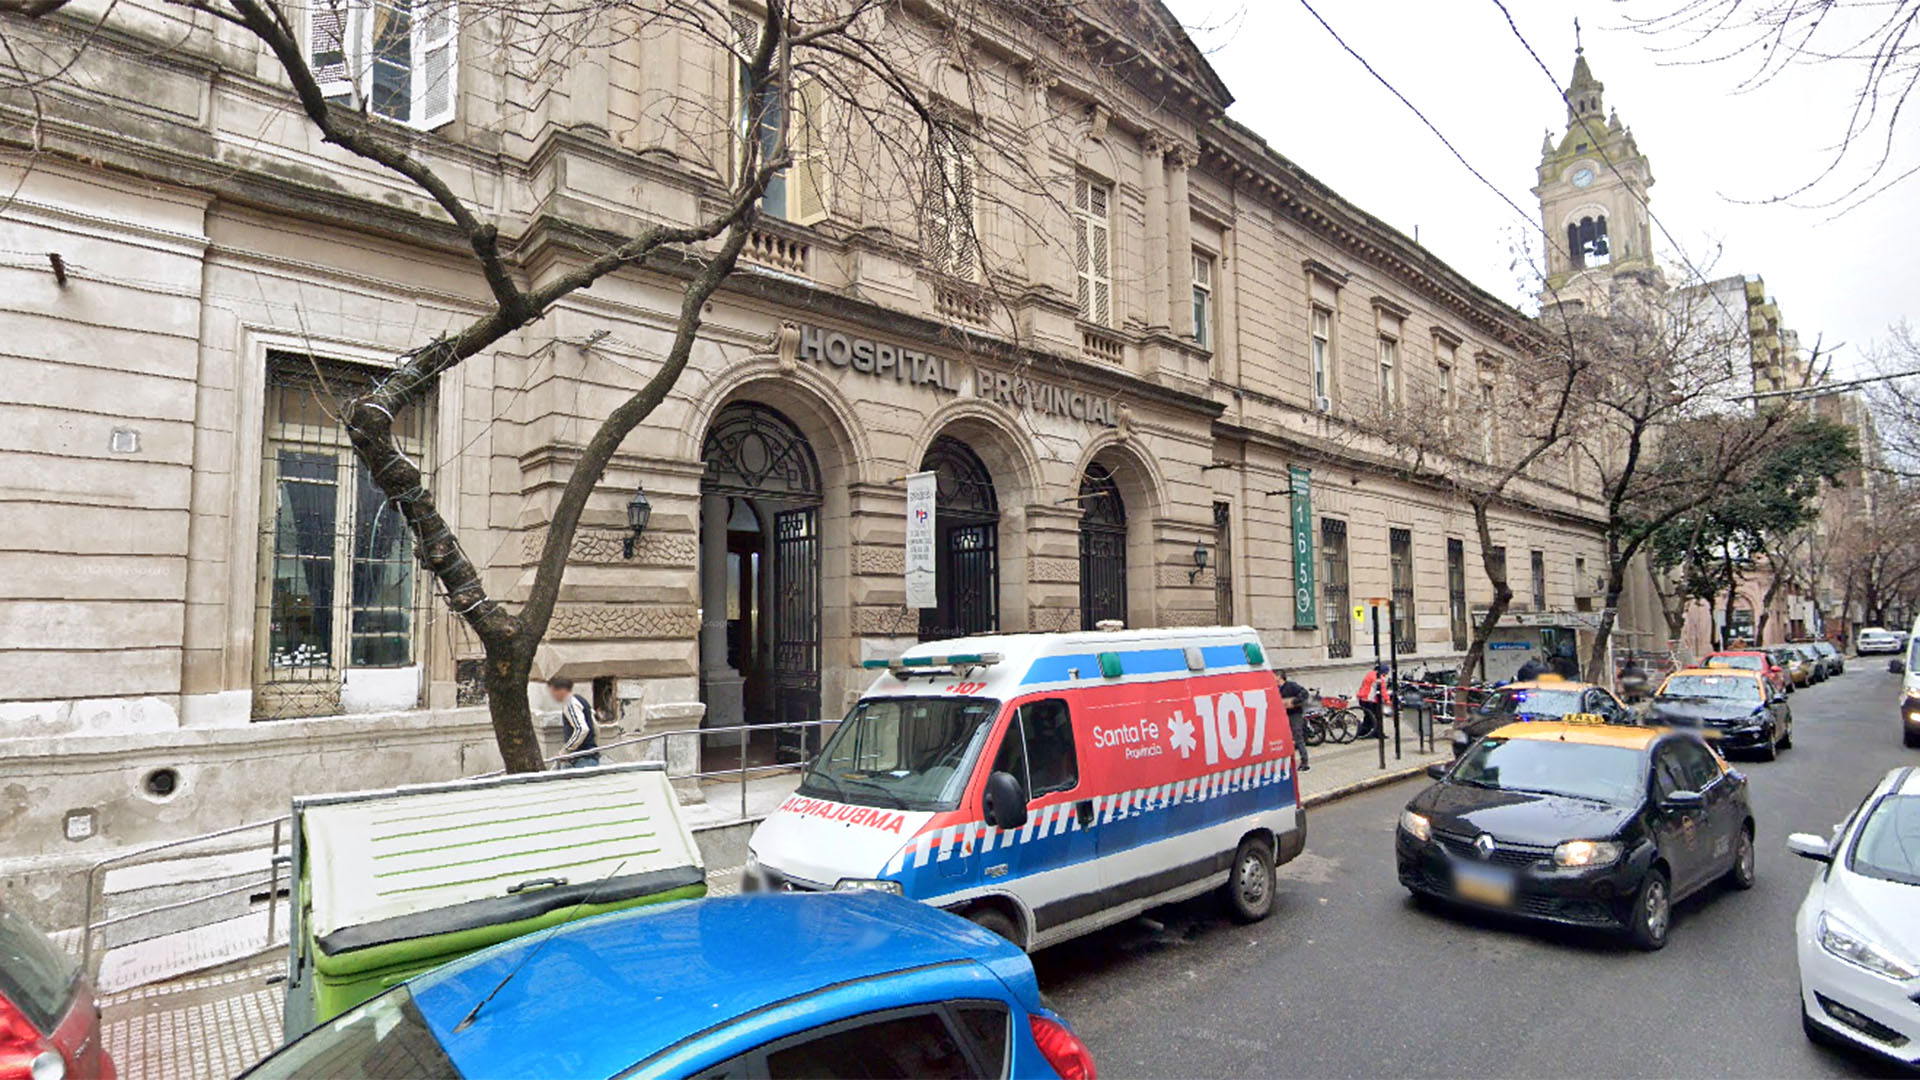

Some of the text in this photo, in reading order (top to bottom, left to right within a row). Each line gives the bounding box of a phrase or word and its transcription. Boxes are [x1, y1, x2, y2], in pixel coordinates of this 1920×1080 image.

[801, 325, 1118, 426] HOSPITAL PROVINCIAL
[1093, 719, 1160, 748] Santa Fe
[1125, 743, 1163, 760] Provincia
[1193, 689, 1268, 765] 107
